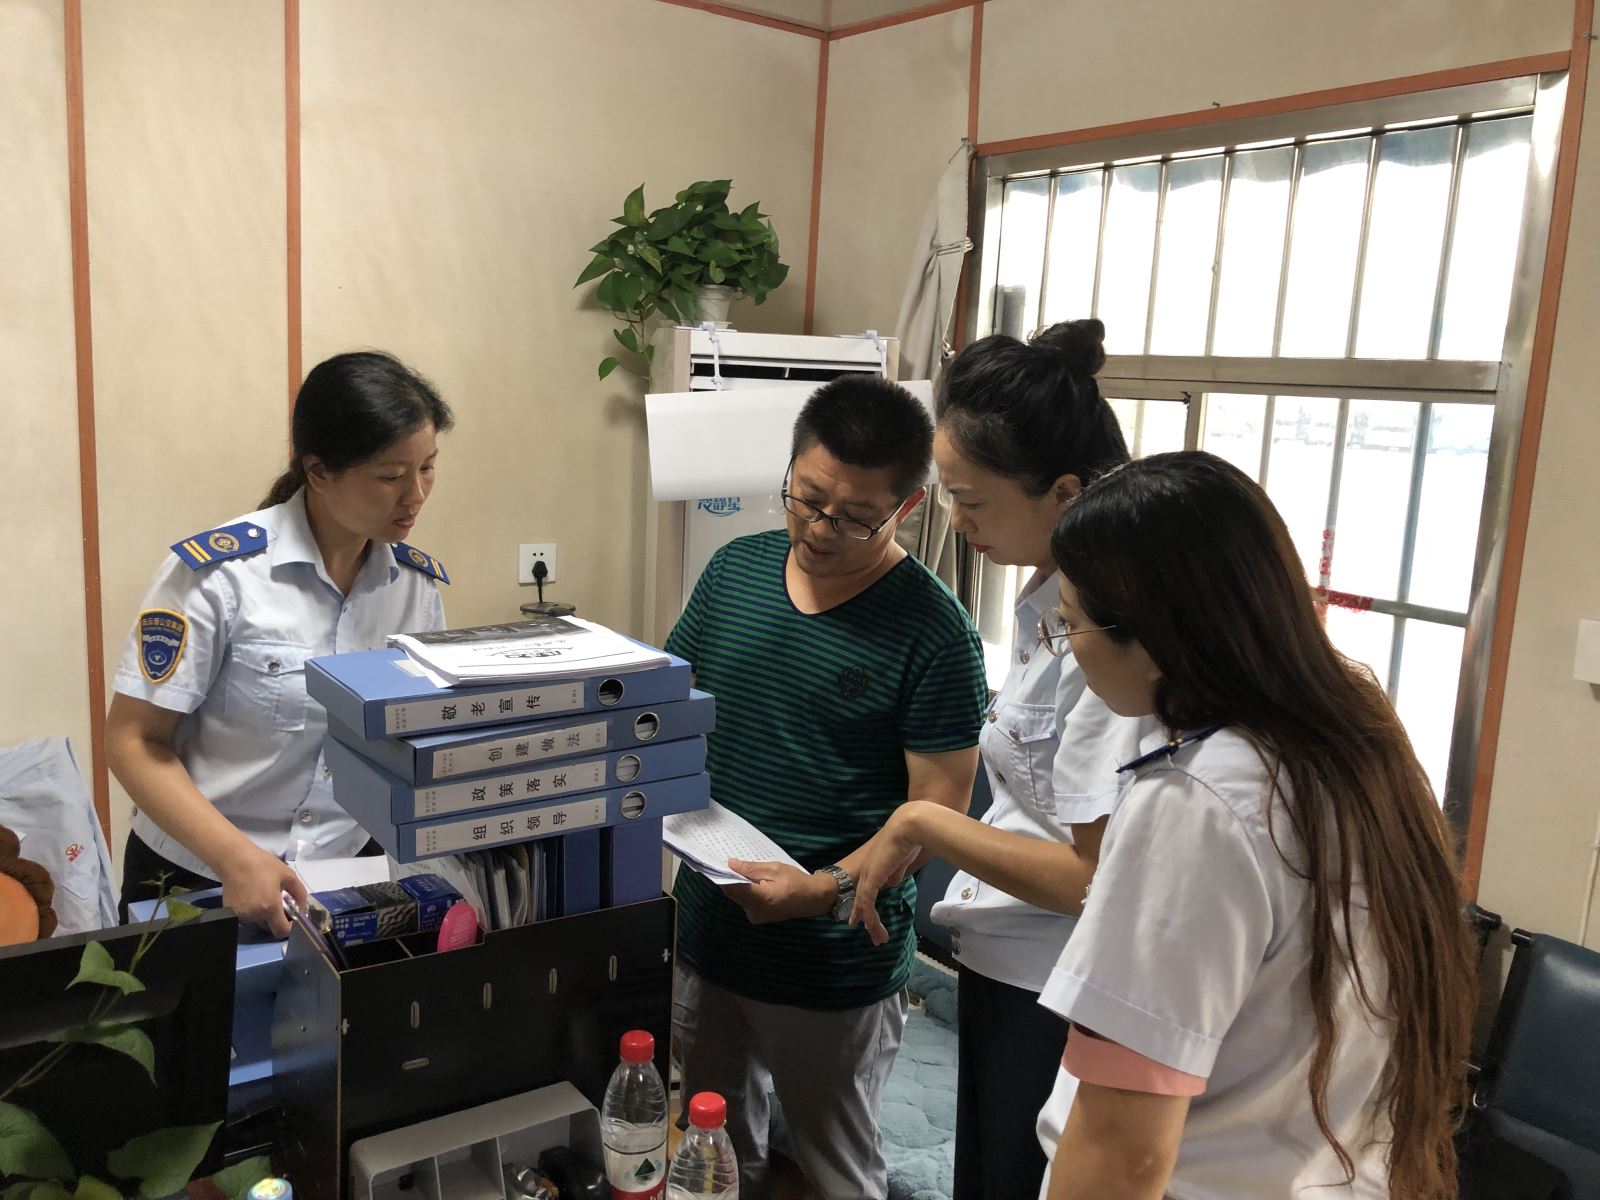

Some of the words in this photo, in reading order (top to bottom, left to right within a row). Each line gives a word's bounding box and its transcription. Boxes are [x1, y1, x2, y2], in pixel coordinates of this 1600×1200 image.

[441, 694, 541, 721] 敬老宣传
[488, 731, 581, 762] 创建做法
[472, 772, 567, 802] 政策落实
[472, 811, 568, 840] 组织领导
